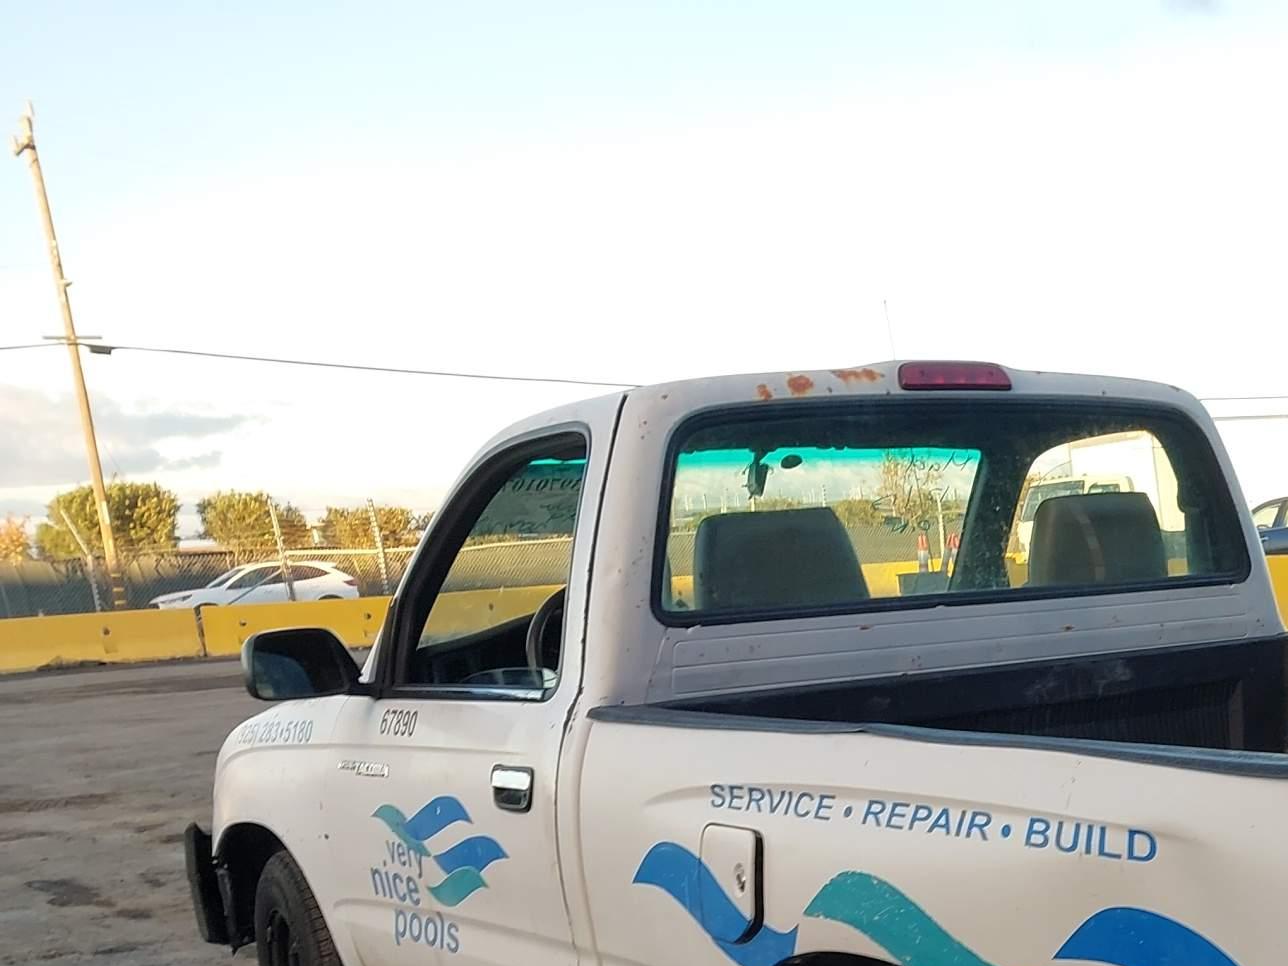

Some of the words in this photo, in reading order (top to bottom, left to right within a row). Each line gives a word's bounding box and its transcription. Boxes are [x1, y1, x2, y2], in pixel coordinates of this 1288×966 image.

[379, 709, 418, 738] 67890
[710, 784, 836, 821] SERVICE
[861, 799, 993, 842] REPAIR
[1024, 817, 1159, 863] BUILD
[385, 839, 423, 879] very
[370, 860, 421, 906] nice
[394, 908, 460, 954] pools
